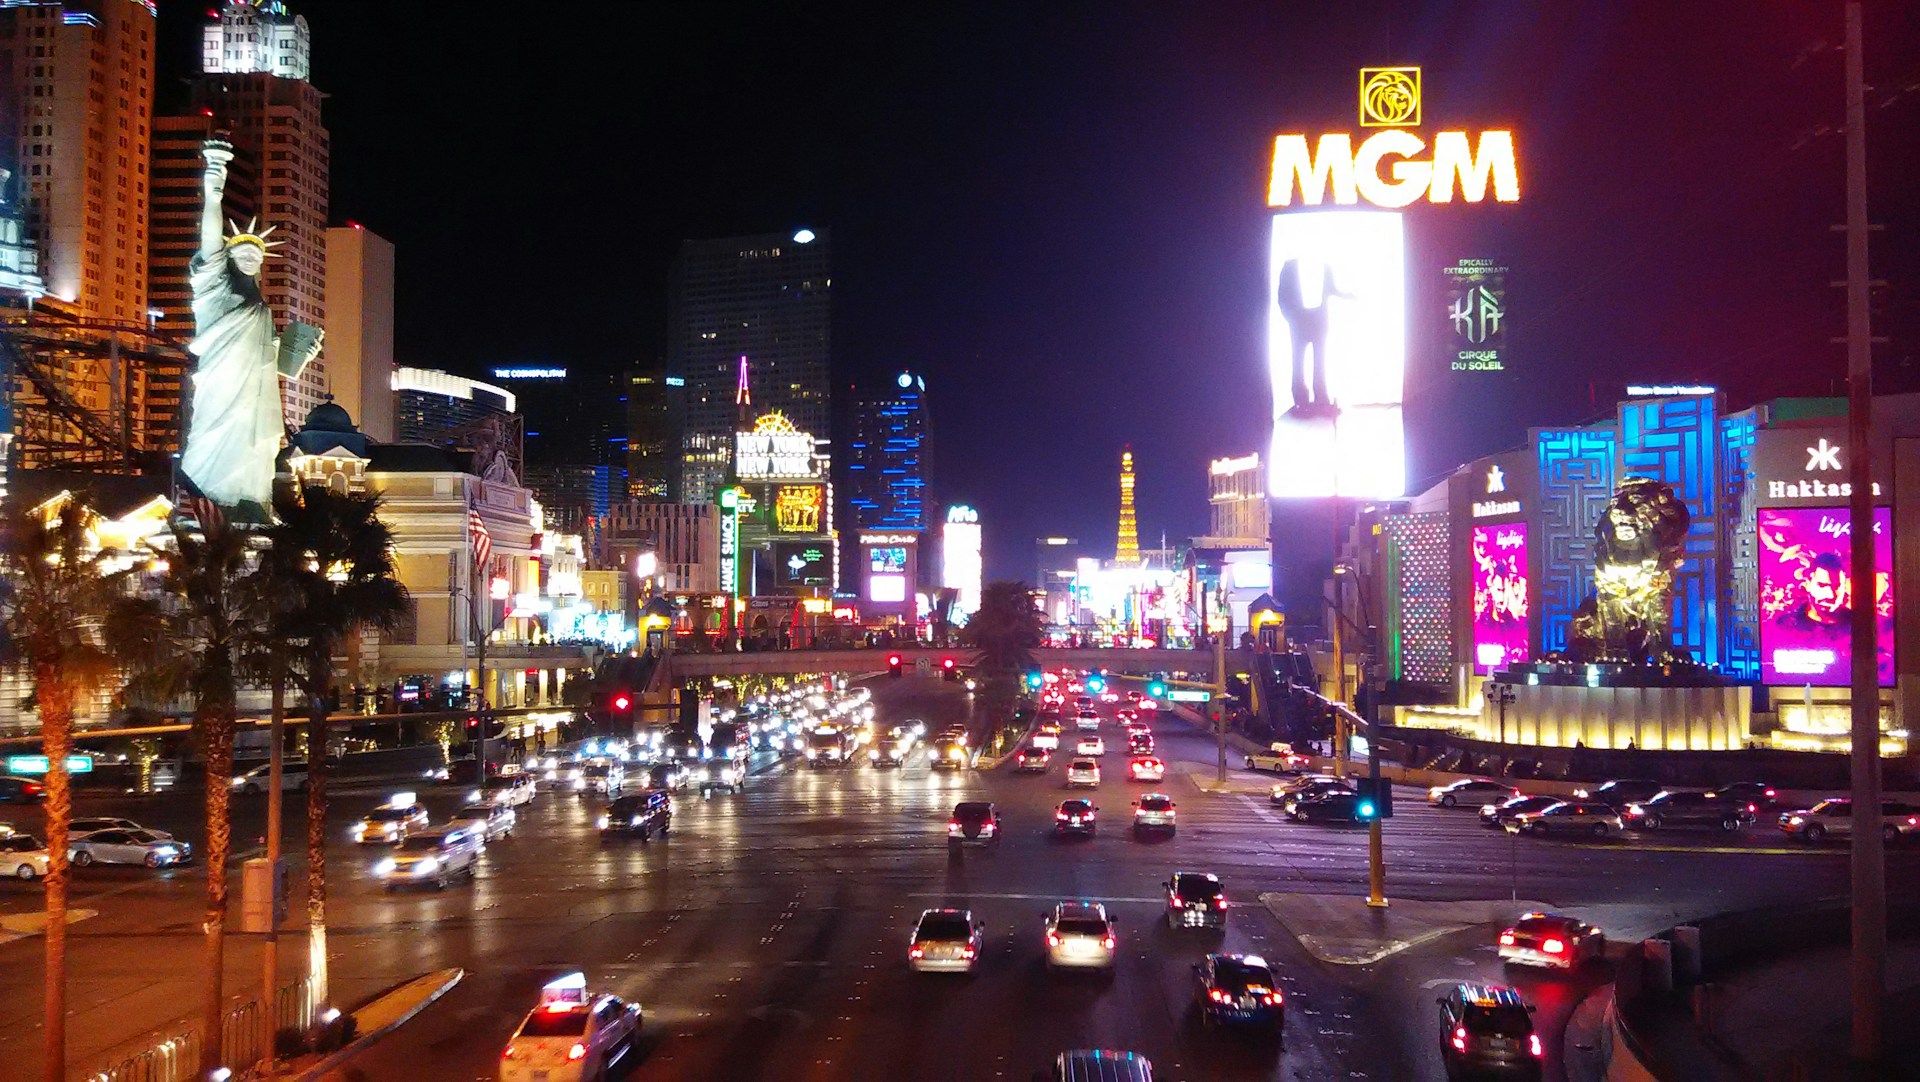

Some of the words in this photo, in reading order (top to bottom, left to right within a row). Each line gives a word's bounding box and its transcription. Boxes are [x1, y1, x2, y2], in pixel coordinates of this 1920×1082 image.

[1267, 129, 1520, 208] MGM
[1443, 267, 1509, 275] EXTRAORDINARY
[1458, 351, 1498, 362] CIRQUE
[495, 370, 510, 378] THE
[511, 369, 566, 378] COSMOPOLITAN
[1451, 362, 1466, 370] DU
[1468, 362, 1504, 370] SOLEIL
[737, 436, 770, 453] NEW
[737, 457, 770, 474] NEW
[1768, 480, 1881, 498] Hakkasn
[721, 514, 734, 555] SHACK
[721, 558, 734, 593] HAKE
